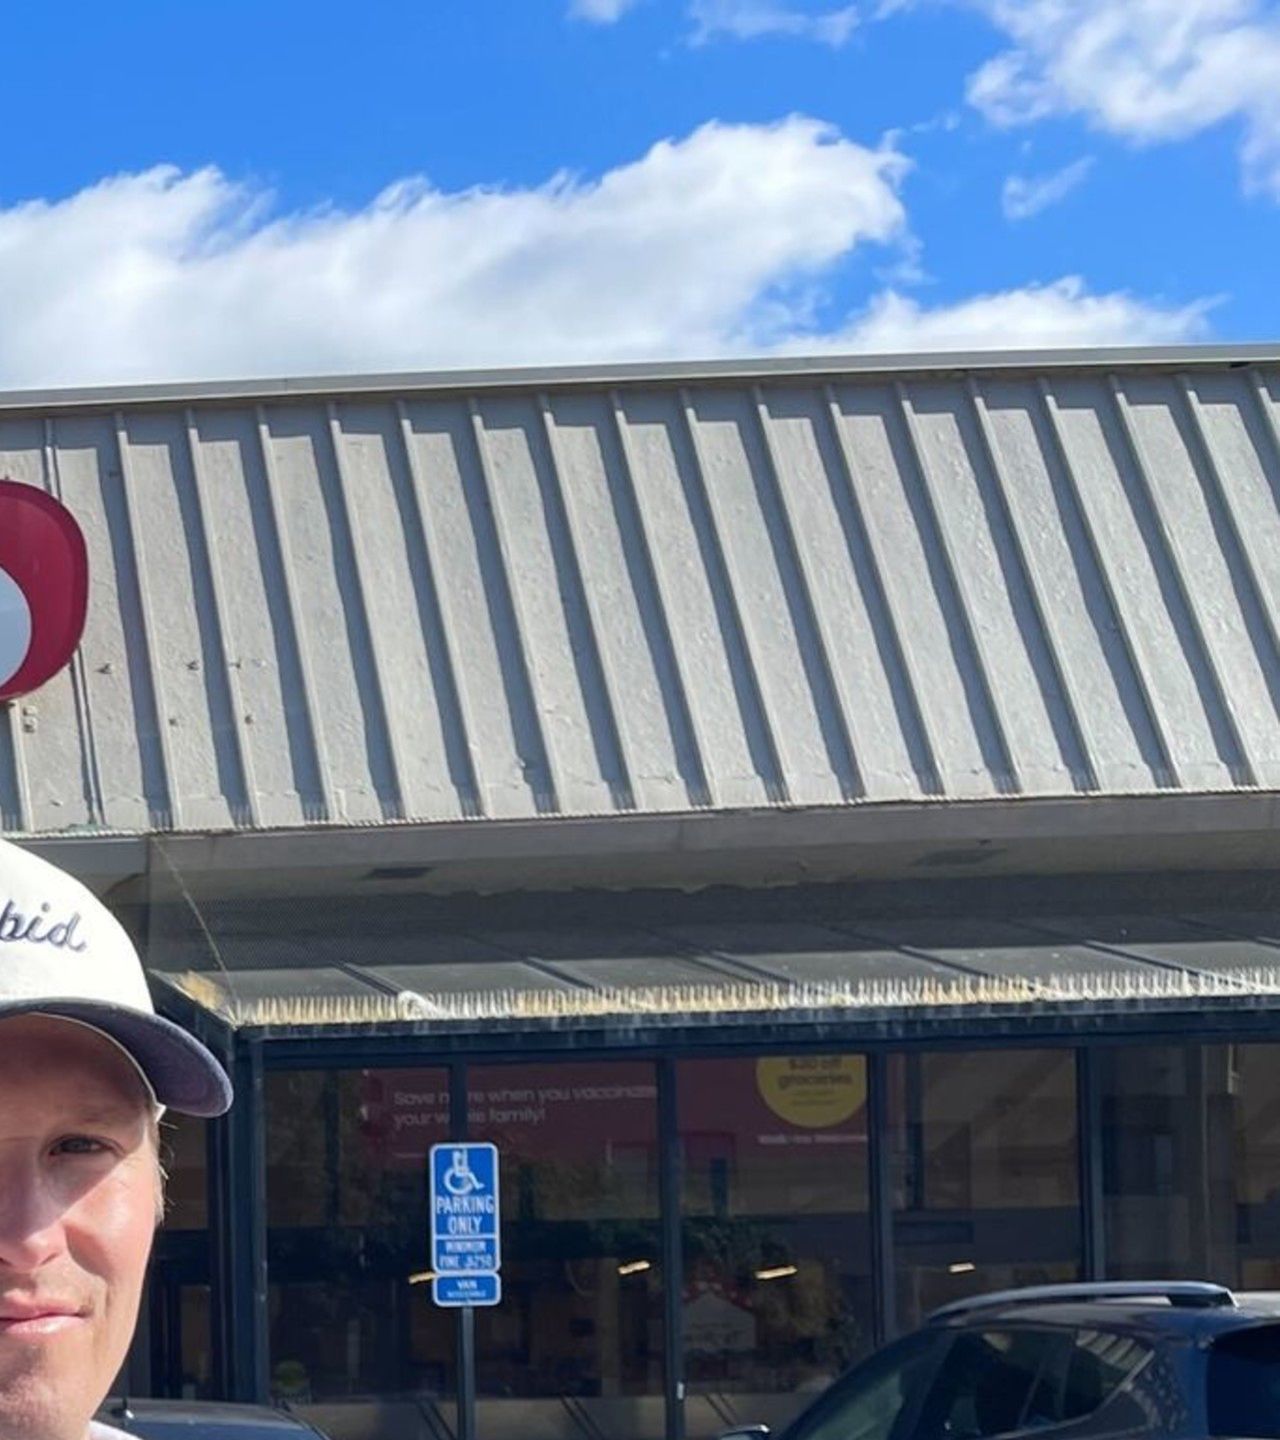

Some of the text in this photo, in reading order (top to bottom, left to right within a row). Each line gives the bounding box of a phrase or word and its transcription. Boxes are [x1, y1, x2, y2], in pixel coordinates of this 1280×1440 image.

[394, 1091, 435, 1106] Save
[488, 1088, 537, 1103] when
[539, 1088, 570, 1105] you
[394, 1111, 433, 1130] your
[436, 1195, 494, 1214] PARKING
[447, 1216, 483, 1235] ONLY
